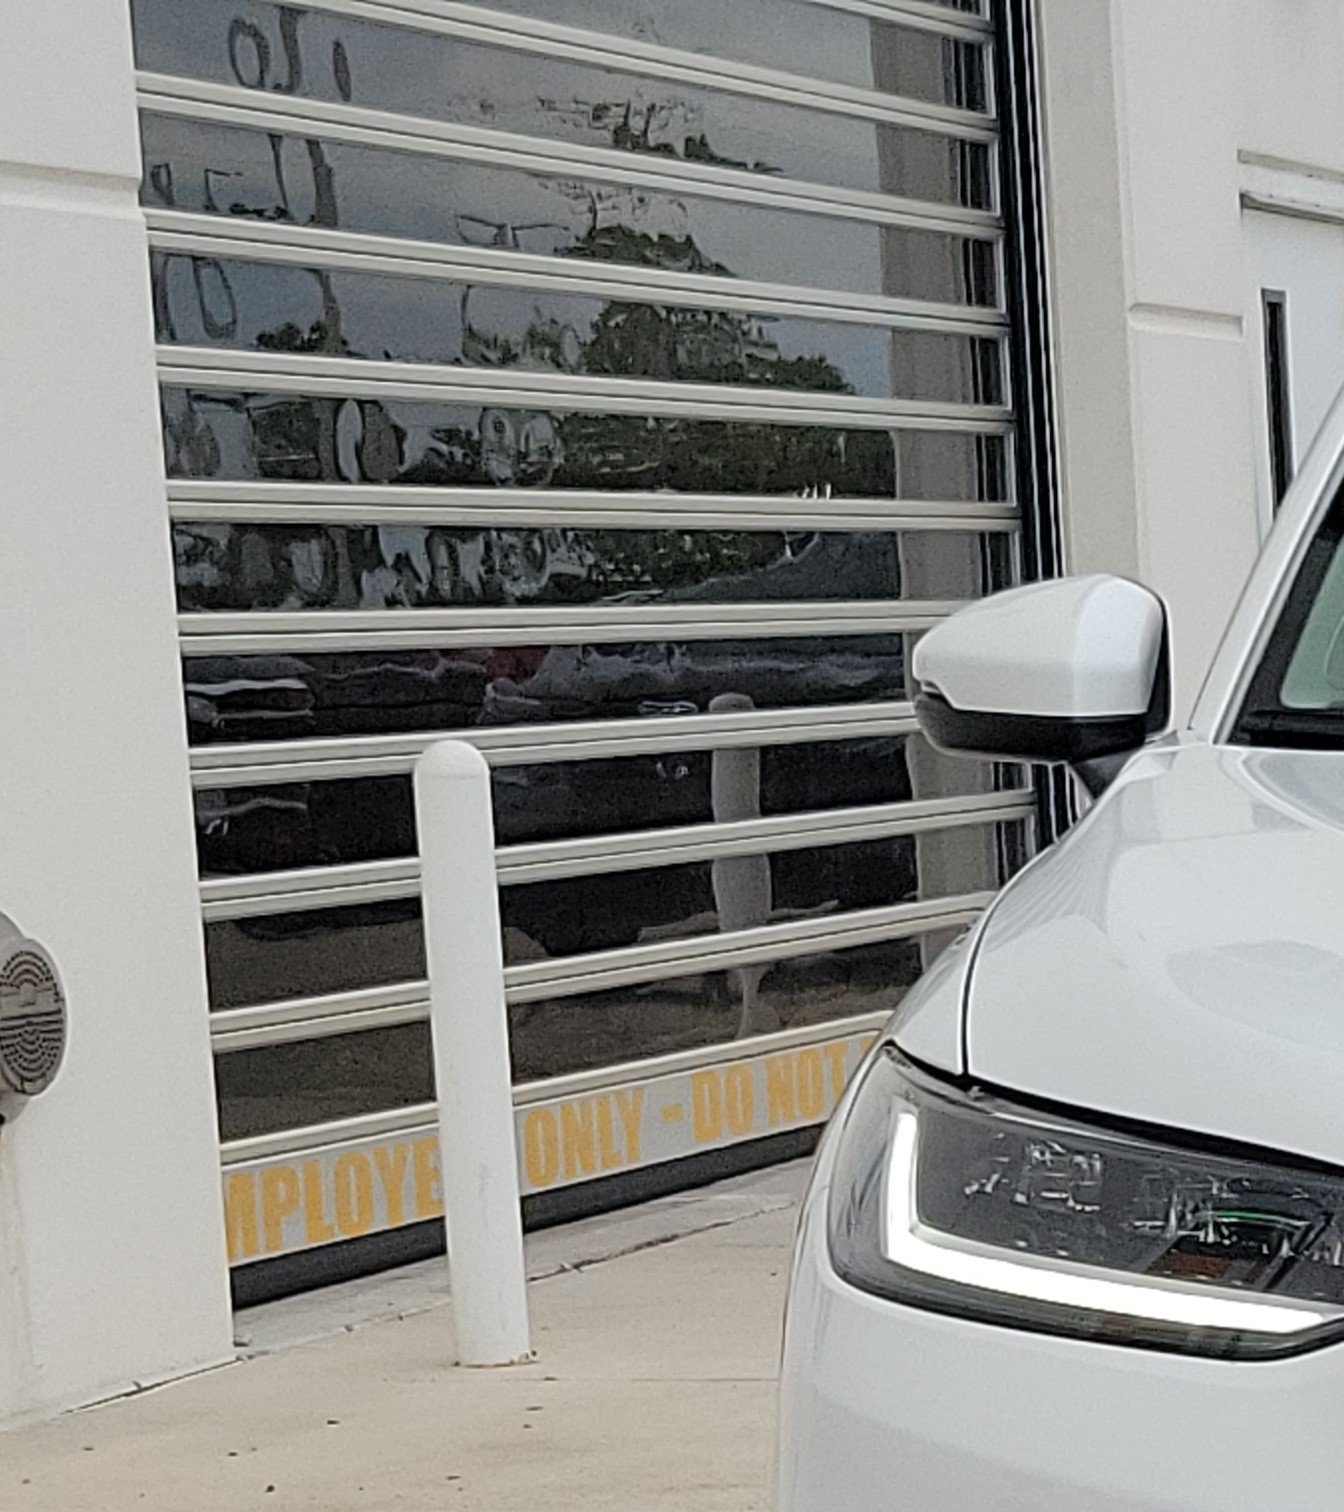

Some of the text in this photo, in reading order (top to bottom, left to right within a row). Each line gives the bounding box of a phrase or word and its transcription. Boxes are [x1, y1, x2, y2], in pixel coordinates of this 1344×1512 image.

[524, 1085, 645, 1187] ONLY
[691, 1063, 755, 1142] DO
[765, 1040, 849, 1126] NOT
